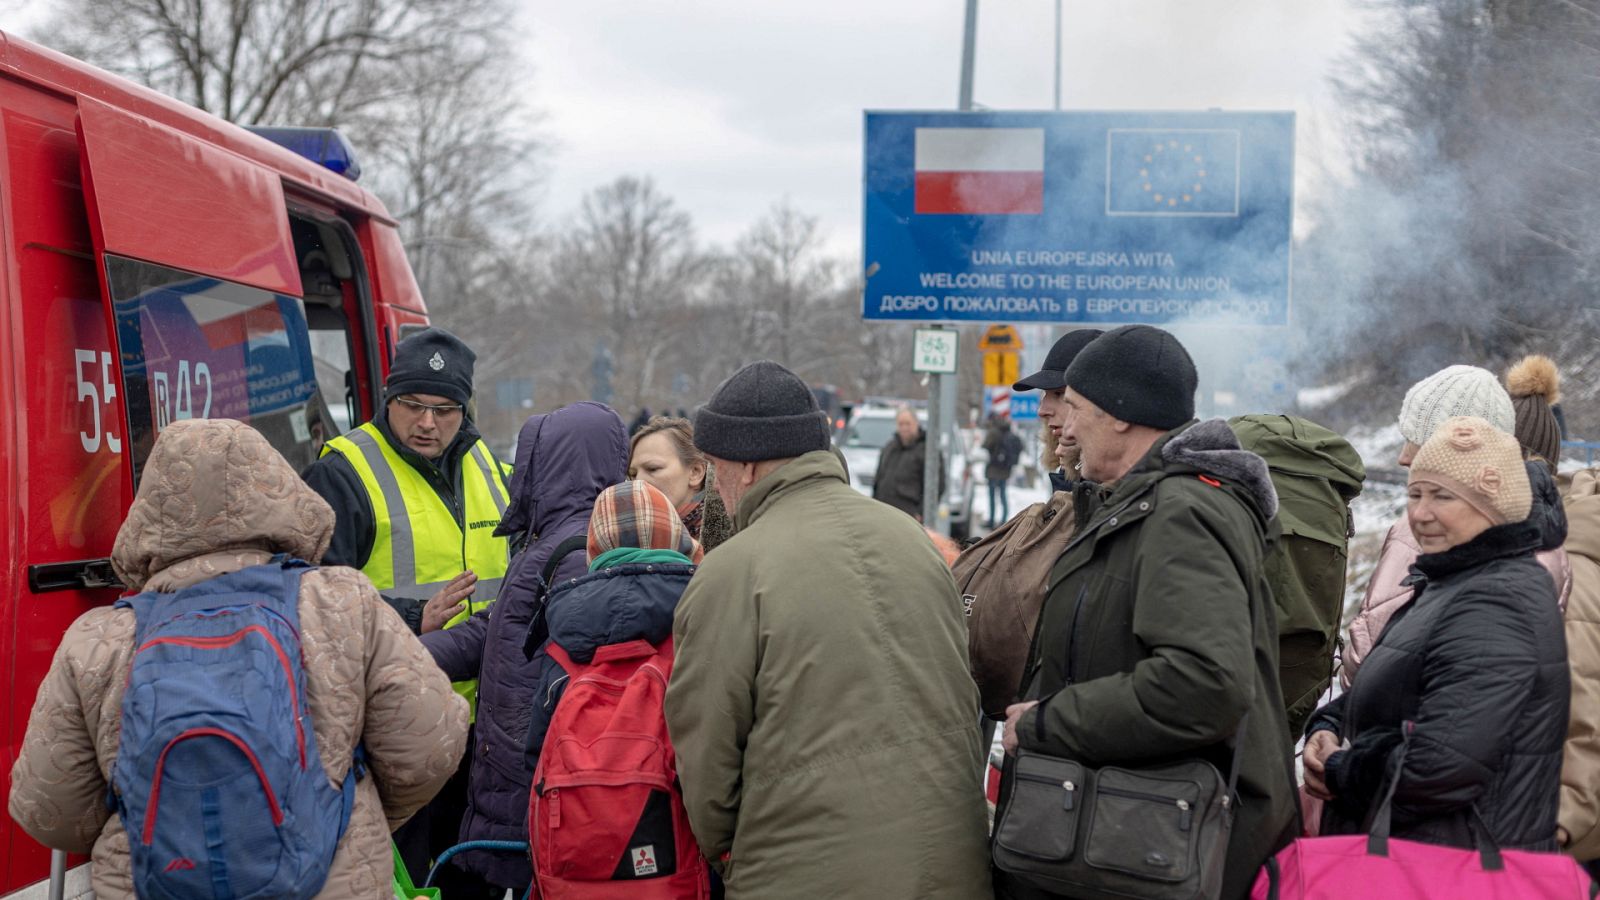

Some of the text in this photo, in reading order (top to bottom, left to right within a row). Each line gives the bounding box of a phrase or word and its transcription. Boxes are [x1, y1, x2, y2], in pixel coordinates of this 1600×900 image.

[971, 250, 1175, 267] UNIA EUROPEJSKA WITA
[919, 272, 1231, 292] WELCOME TO THE EUROPEAN UNION
[879, 295, 939, 313] ДОБРО
[943, 296, 1061, 313] ПОЖАЛОВАТЬ
[1066, 298, 1079, 313] В
